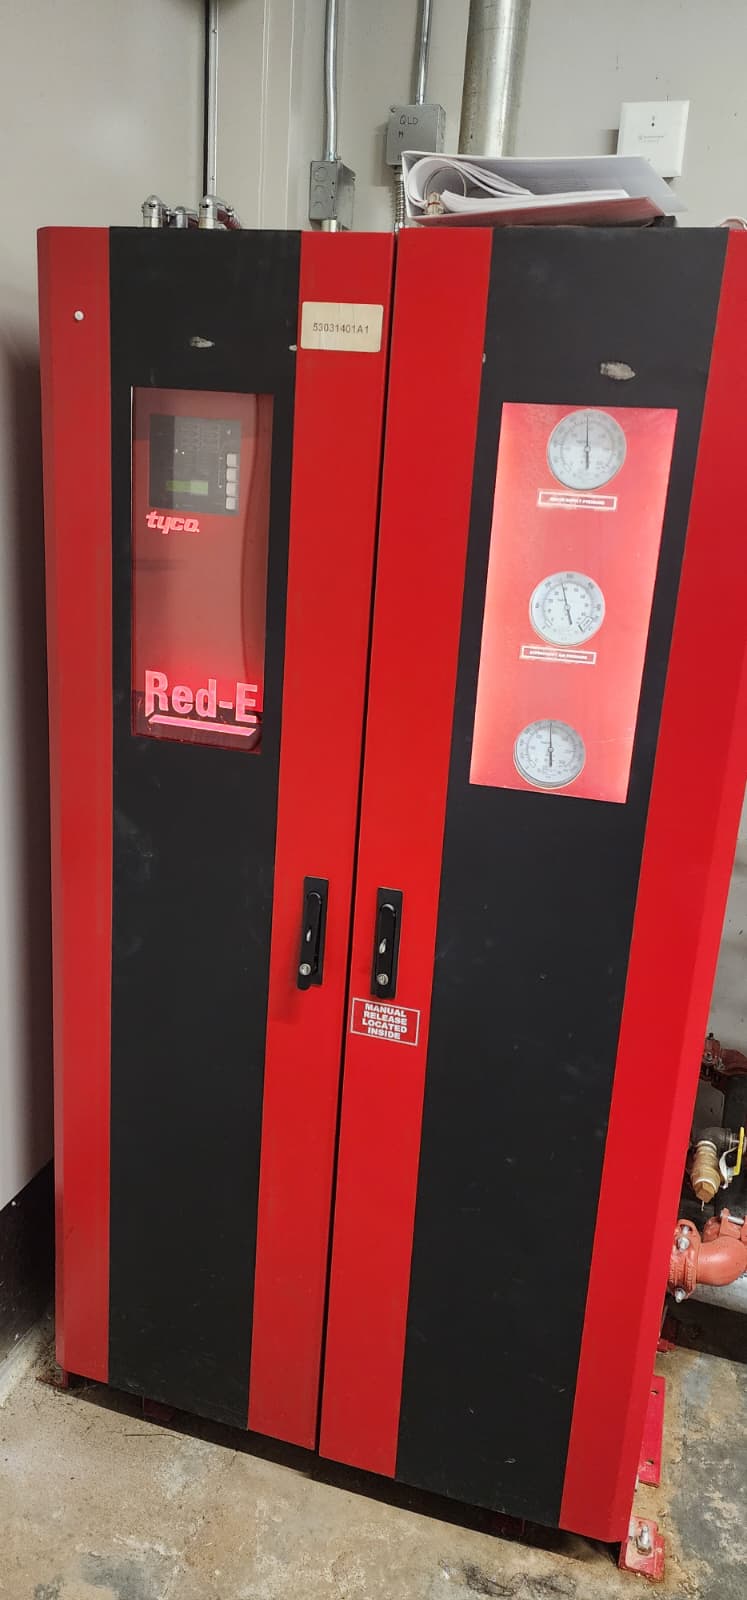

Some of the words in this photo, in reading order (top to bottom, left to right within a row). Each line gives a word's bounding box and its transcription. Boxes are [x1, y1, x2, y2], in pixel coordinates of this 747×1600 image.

[312, 322, 370, 334] 53031401A1
[145, 670, 257, 723] Red-E
[365, 1003, 406, 1017] MANUAL
[363, 1011, 407, 1025] RELEASE
[362, 1018, 407, 1033] LOCATED
[367, 1027, 400, 1039] INSIDE
